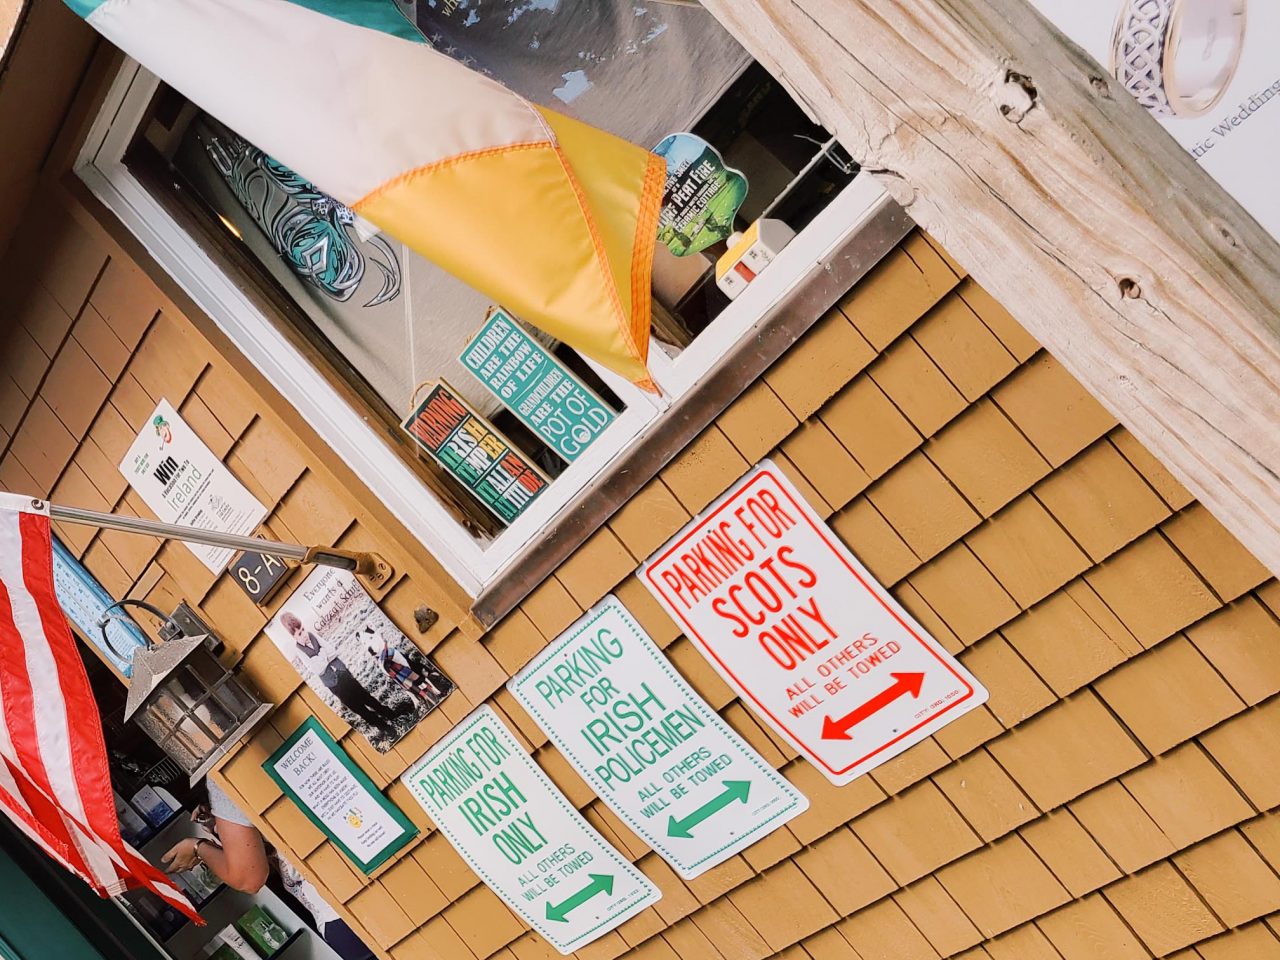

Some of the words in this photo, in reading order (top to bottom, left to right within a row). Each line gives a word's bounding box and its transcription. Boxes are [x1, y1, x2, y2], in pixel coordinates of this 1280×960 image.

[671, 177, 698, 208] PEAT
[691, 159, 716, 184] FIRE
[673, 204, 700, 233] CERAMIC
[695, 179, 721, 207] COTTAGE
[465, 316, 512, 369] CHILDREN
[479, 355, 503, 380] ARE
[498, 331, 523, 356] THE
[488, 341, 532, 390] RAINBOW
[500, 377, 519, 399] OF
[515, 351, 544, 381] LIFE
[517, 367, 564, 416] GRANDCHILDREN
[408, 389, 468, 450] WARNING
[530, 401, 554, 427] ARE
[549, 379, 574, 405] THE
[539, 412, 569, 443] POT
[566, 389, 592, 416] OF
[438, 416, 488, 470] IRISH
[559, 407, 609, 456] GOLD
[153, 455, 180, 487] Win
[455, 433, 506, 484] TEMPER
[475, 451, 526, 502] ITALIAN
[166, 465, 203, 512] Ireland
[493, 469, 544, 520] ATTITUDE
[661, 522, 755, 609] PARKING
[734, 488, 797, 549] FOR
[302, 567, 338, 602] Everyone
[312, 584, 338, 610] wants
[712, 545, 817, 638] SCOTS
[758, 597, 838, 671] ONLY
[535, 628, 624, 710] PARKING
[785, 677, 816, 701] ALL
[817, 632, 879, 678] OTHERS
[788, 693, 825, 719] WILL
[825, 677, 848, 697] BE
[847, 640, 901, 678] TOWED
[579, 677, 620, 714] FOR
[580, 681, 667, 757] IRISH
[281, 737, 314, 772] WELCOME
[293, 751, 316, 777] BACK!
[419, 748, 484, 811] PARKING
[465, 726, 511, 772] FOR
[594, 703, 706, 791] POLICEMEN
[637, 782, 663, 802] ALL
[662, 746, 712, 785] OTHERS
[639, 797, 671, 819] WILL
[670, 783, 690, 799] BE
[687, 753, 733, 787] TOWED
[458, 771, 528, 836] IRISH
[492, 811, 548, 865] ONLY
[517, 870, 539, 888] ALL
[536, 843, 576, 874] OTHERS
[521, 883, 548, 902] WILL
[545, 873, 561, 888] BE
[558, 850, 594, 878] TOWED
